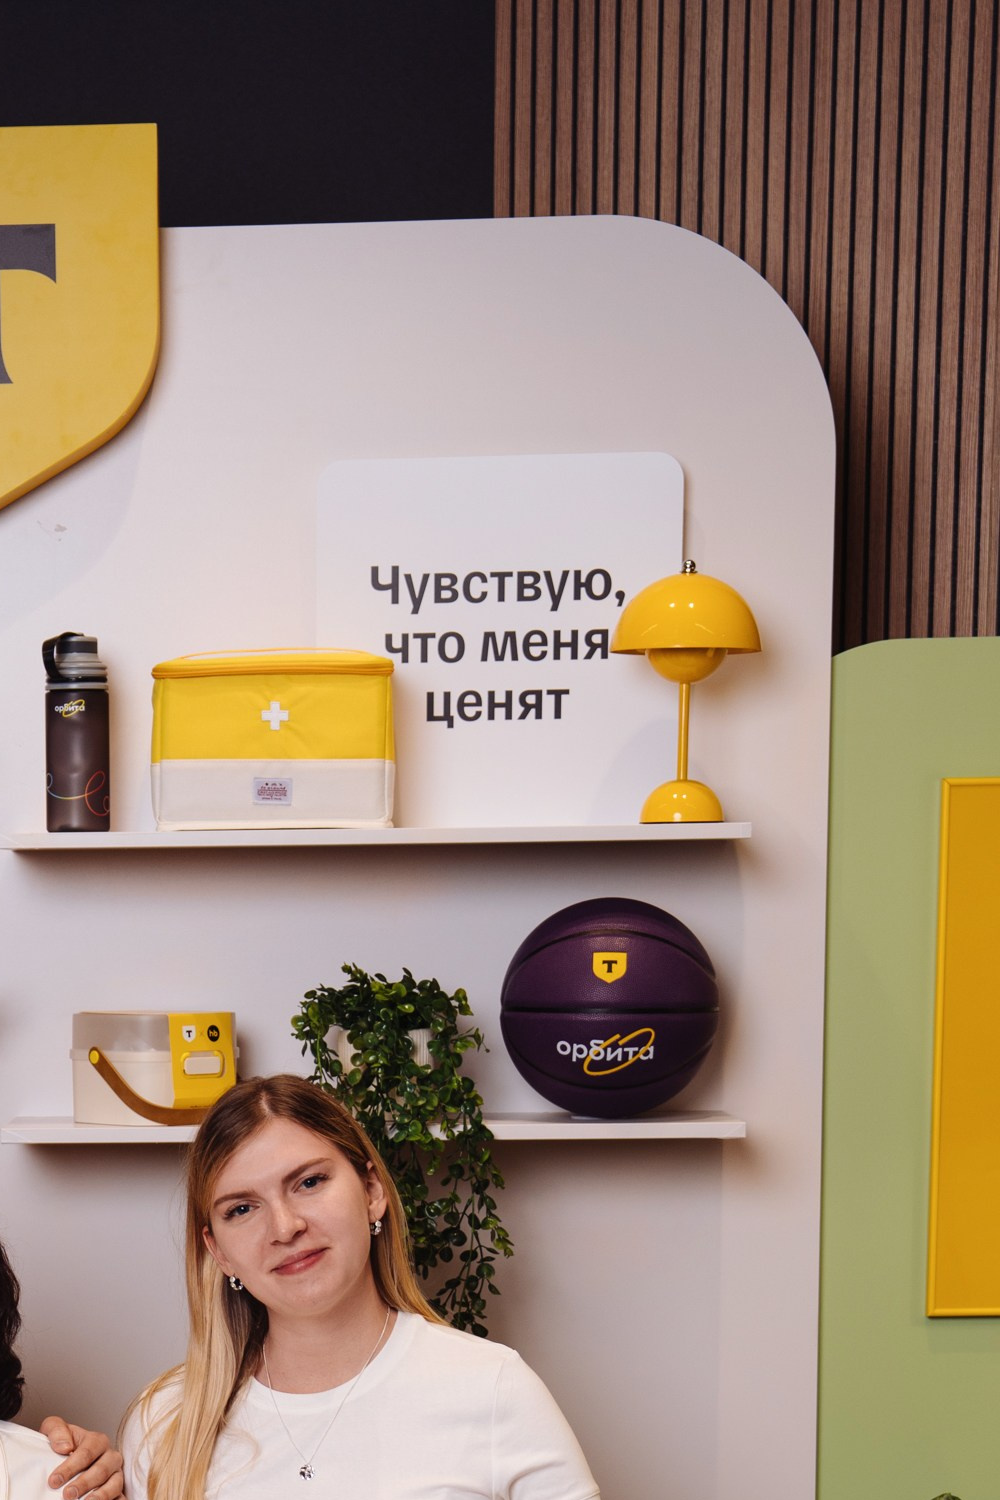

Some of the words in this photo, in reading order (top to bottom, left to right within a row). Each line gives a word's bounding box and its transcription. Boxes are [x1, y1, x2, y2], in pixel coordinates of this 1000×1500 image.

[370, 564, 626, 615] Чувствую,
[384, 630, 466, 664] что
[480, 627, 610, 663] меня
[425, 687, 571, 729] ценят
[556, 1037, 655, 1063] орбита
